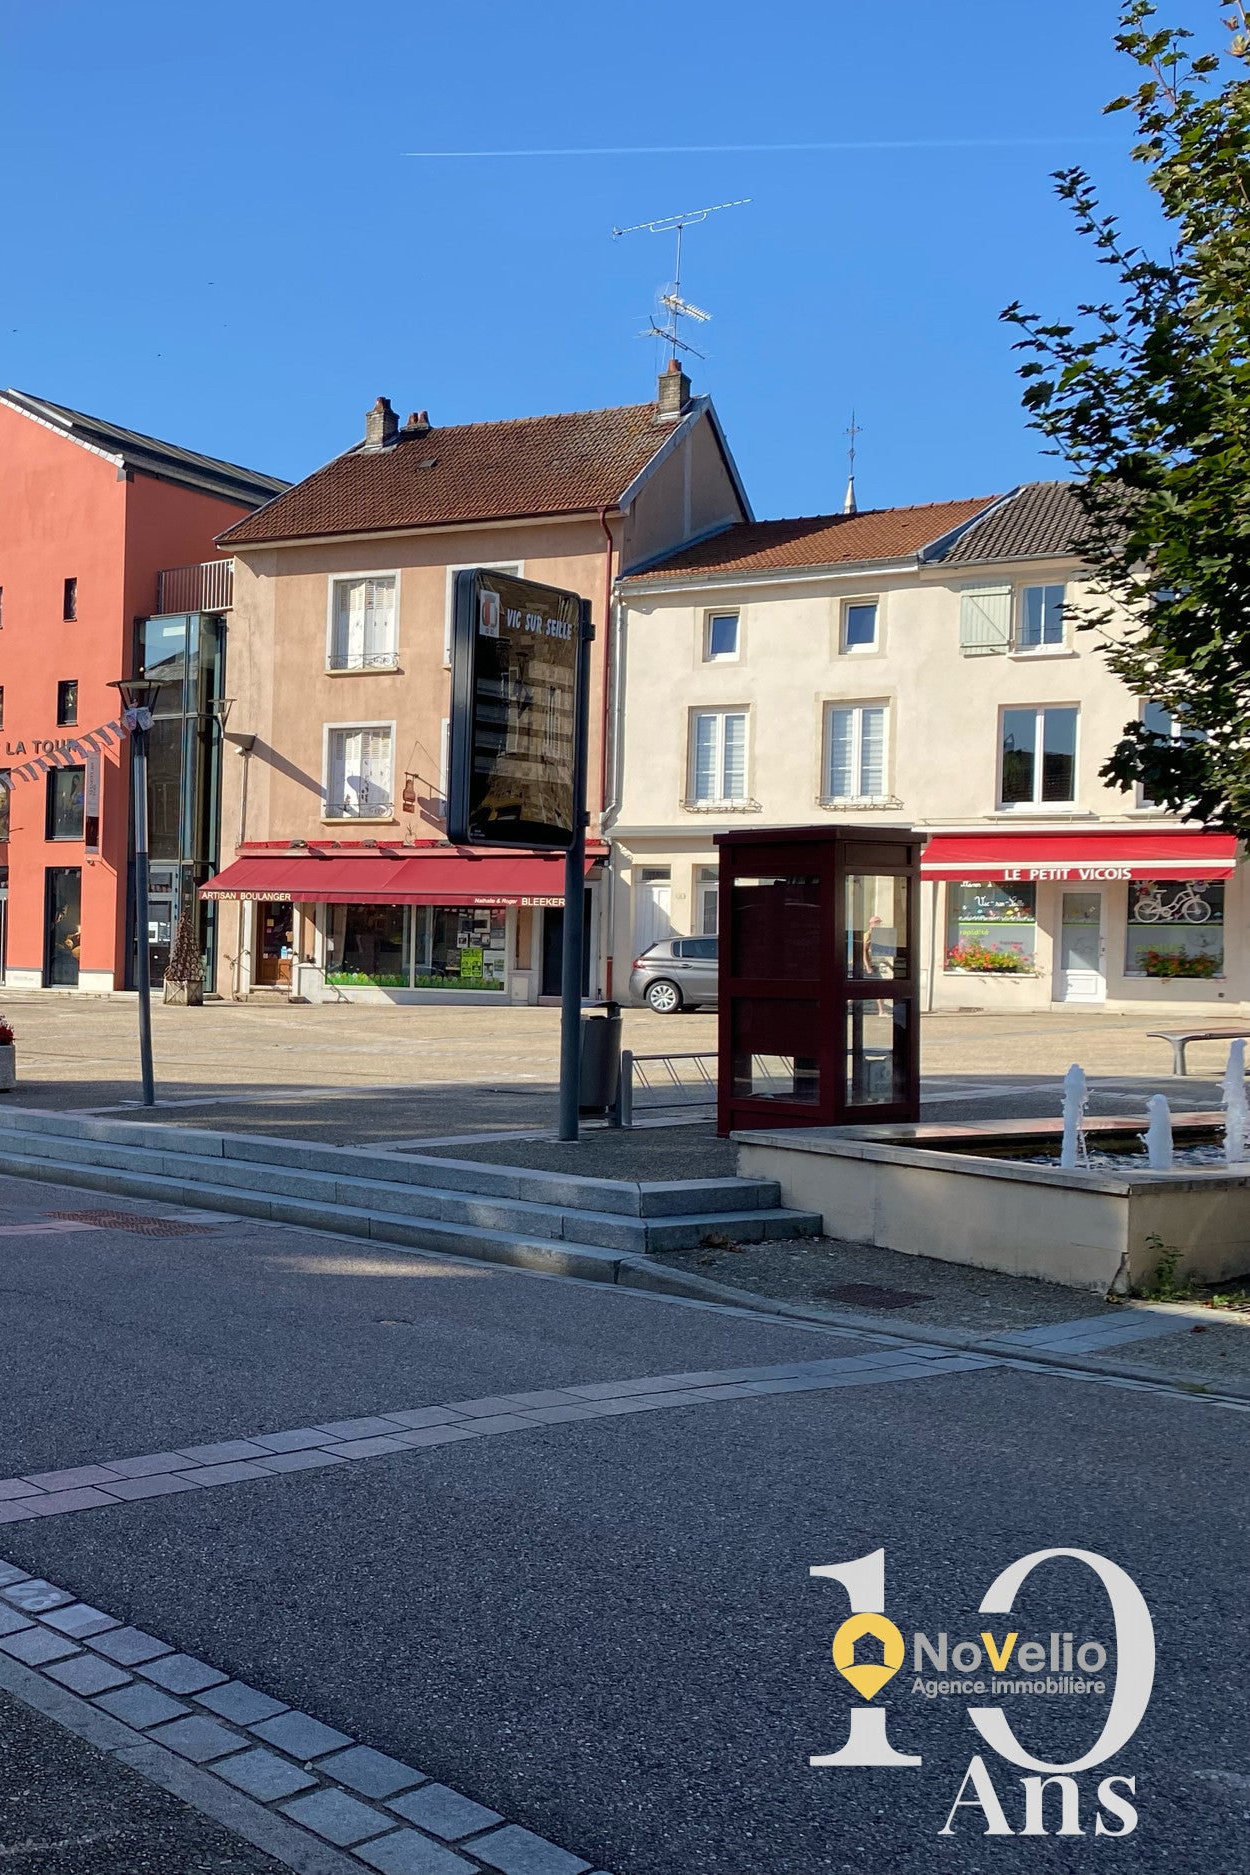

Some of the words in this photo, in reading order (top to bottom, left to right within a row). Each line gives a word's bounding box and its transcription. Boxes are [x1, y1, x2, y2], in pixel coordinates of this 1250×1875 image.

[507, 608, 521, 629] VIC
[525, 613, 542, 634] SUR
[546, 619, 572, 640] SEILLE
[5, 740, 27, 756] LA
[1004, 869, 1021, 881] LE
[1030, 868, 1071, 881] PETIT
[1078, 867, 1132, 881] VICOIS
[201, 891, 236, 900] ARTISAN
[240, 892, 292, 901] BOULANGER
[521, 897, 566, 907] BLEEKER
